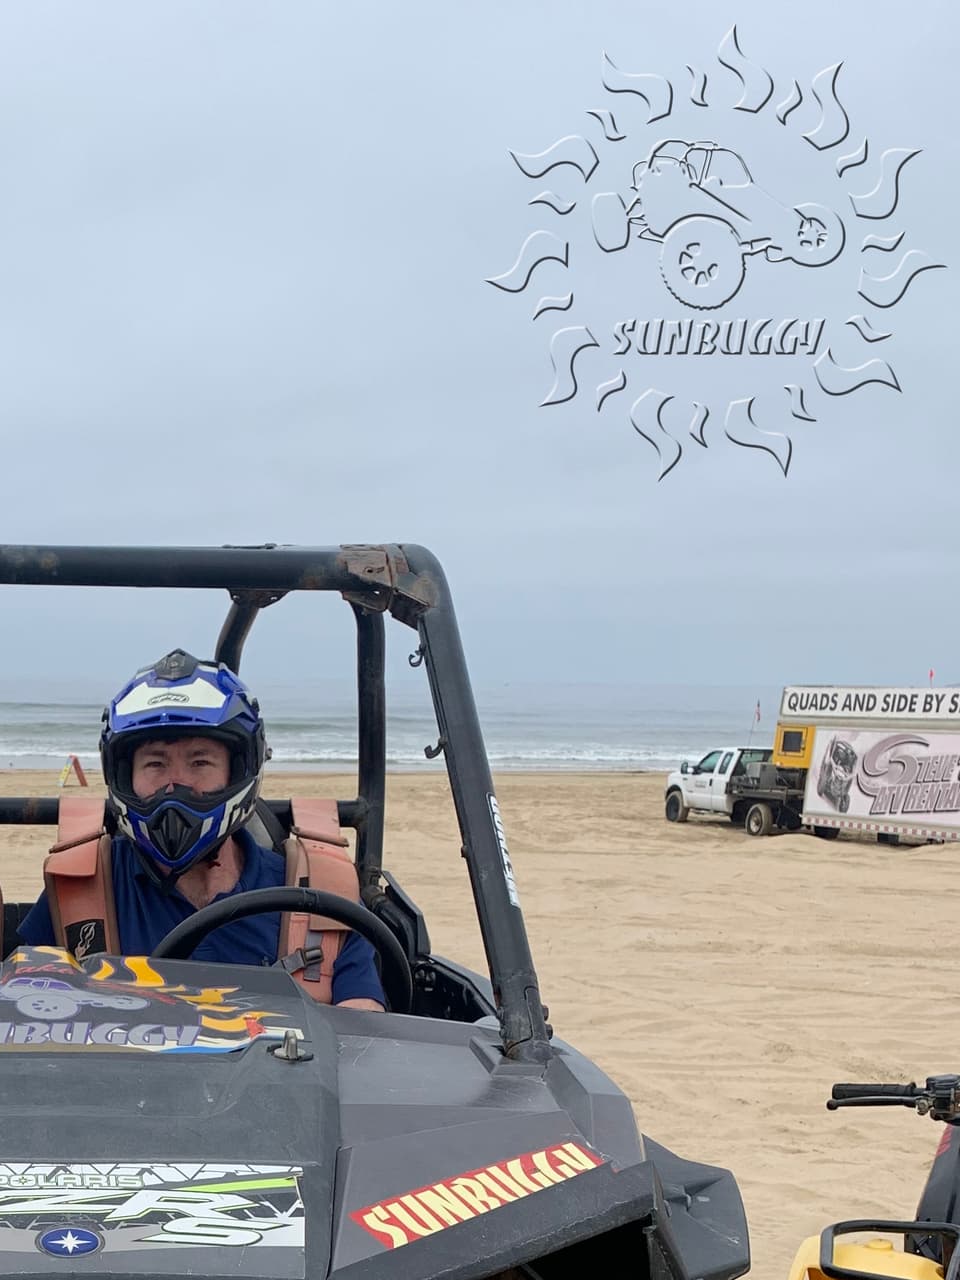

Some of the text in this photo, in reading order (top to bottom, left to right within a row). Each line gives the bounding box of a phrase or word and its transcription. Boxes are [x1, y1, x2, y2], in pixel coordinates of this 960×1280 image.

[788, 692, 960, 714] QUADS AND SIDE BY S
[870, 783, 911, 815] ATV
[361, 1142, 598, 1249] SUNBUGGY
